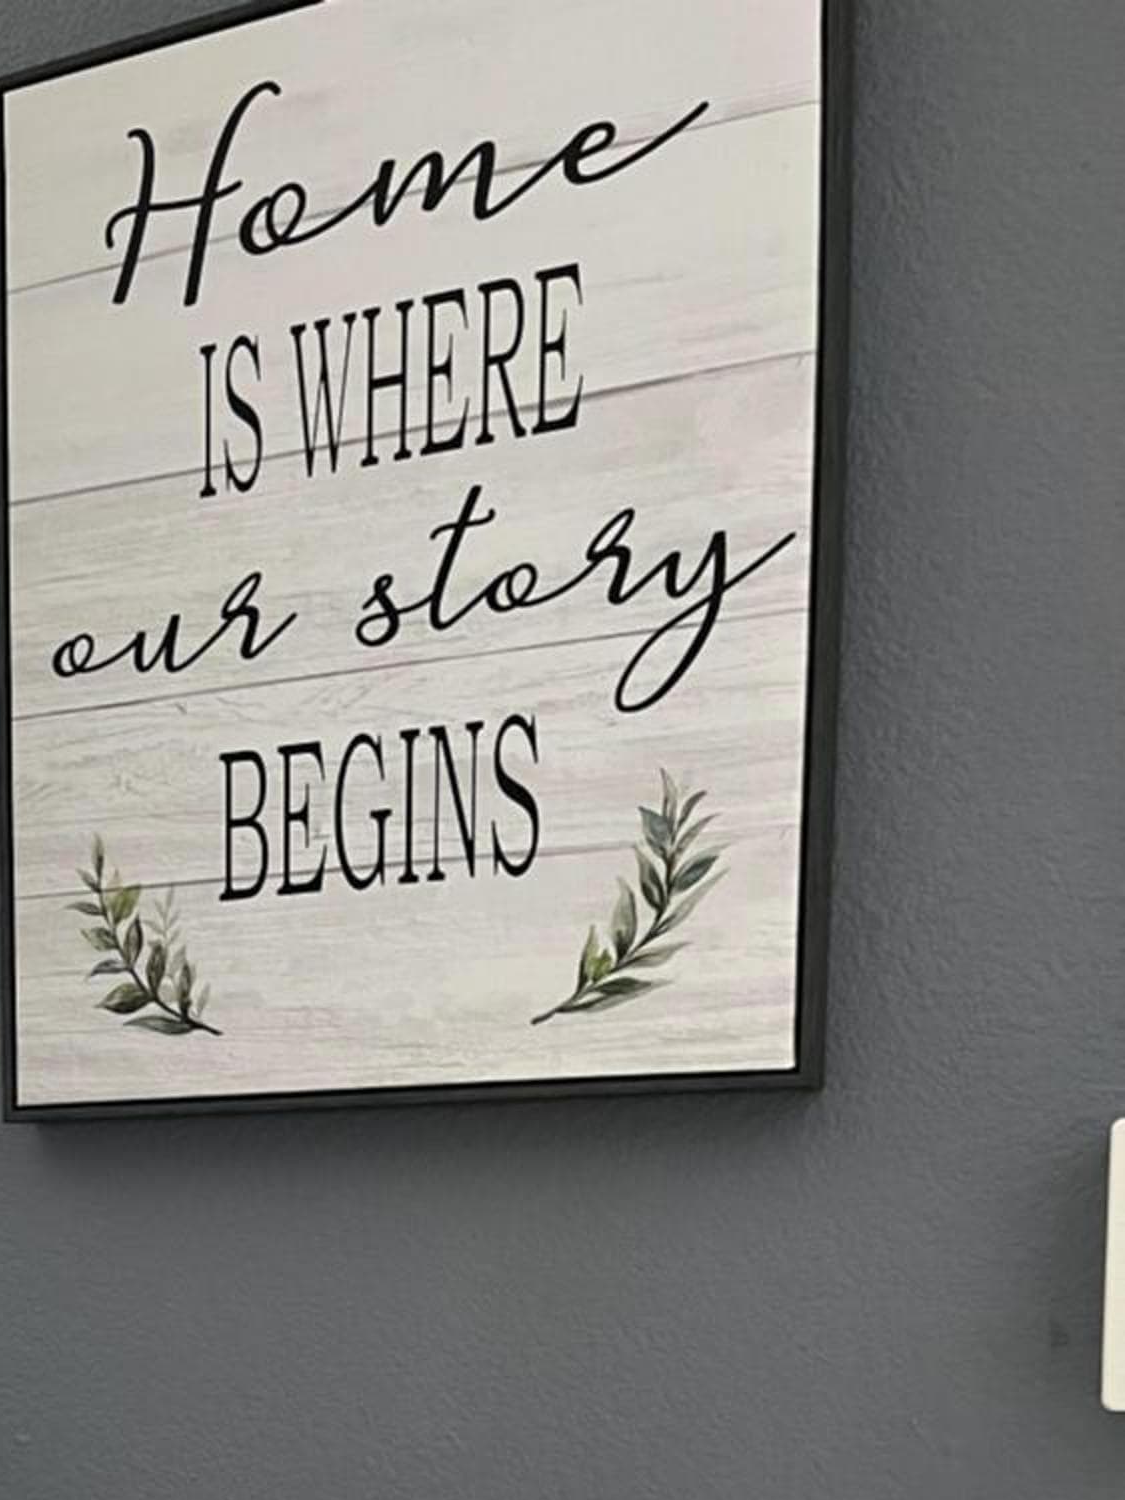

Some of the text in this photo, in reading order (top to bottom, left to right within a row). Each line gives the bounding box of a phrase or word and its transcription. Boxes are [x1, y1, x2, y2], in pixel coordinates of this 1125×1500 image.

[105, 80, 709, 306] Home
[199, 263, 583, 498] IS WHERE
[52, 485, 796, 712] our story
[218, 714, 540, 901] BEGINS
